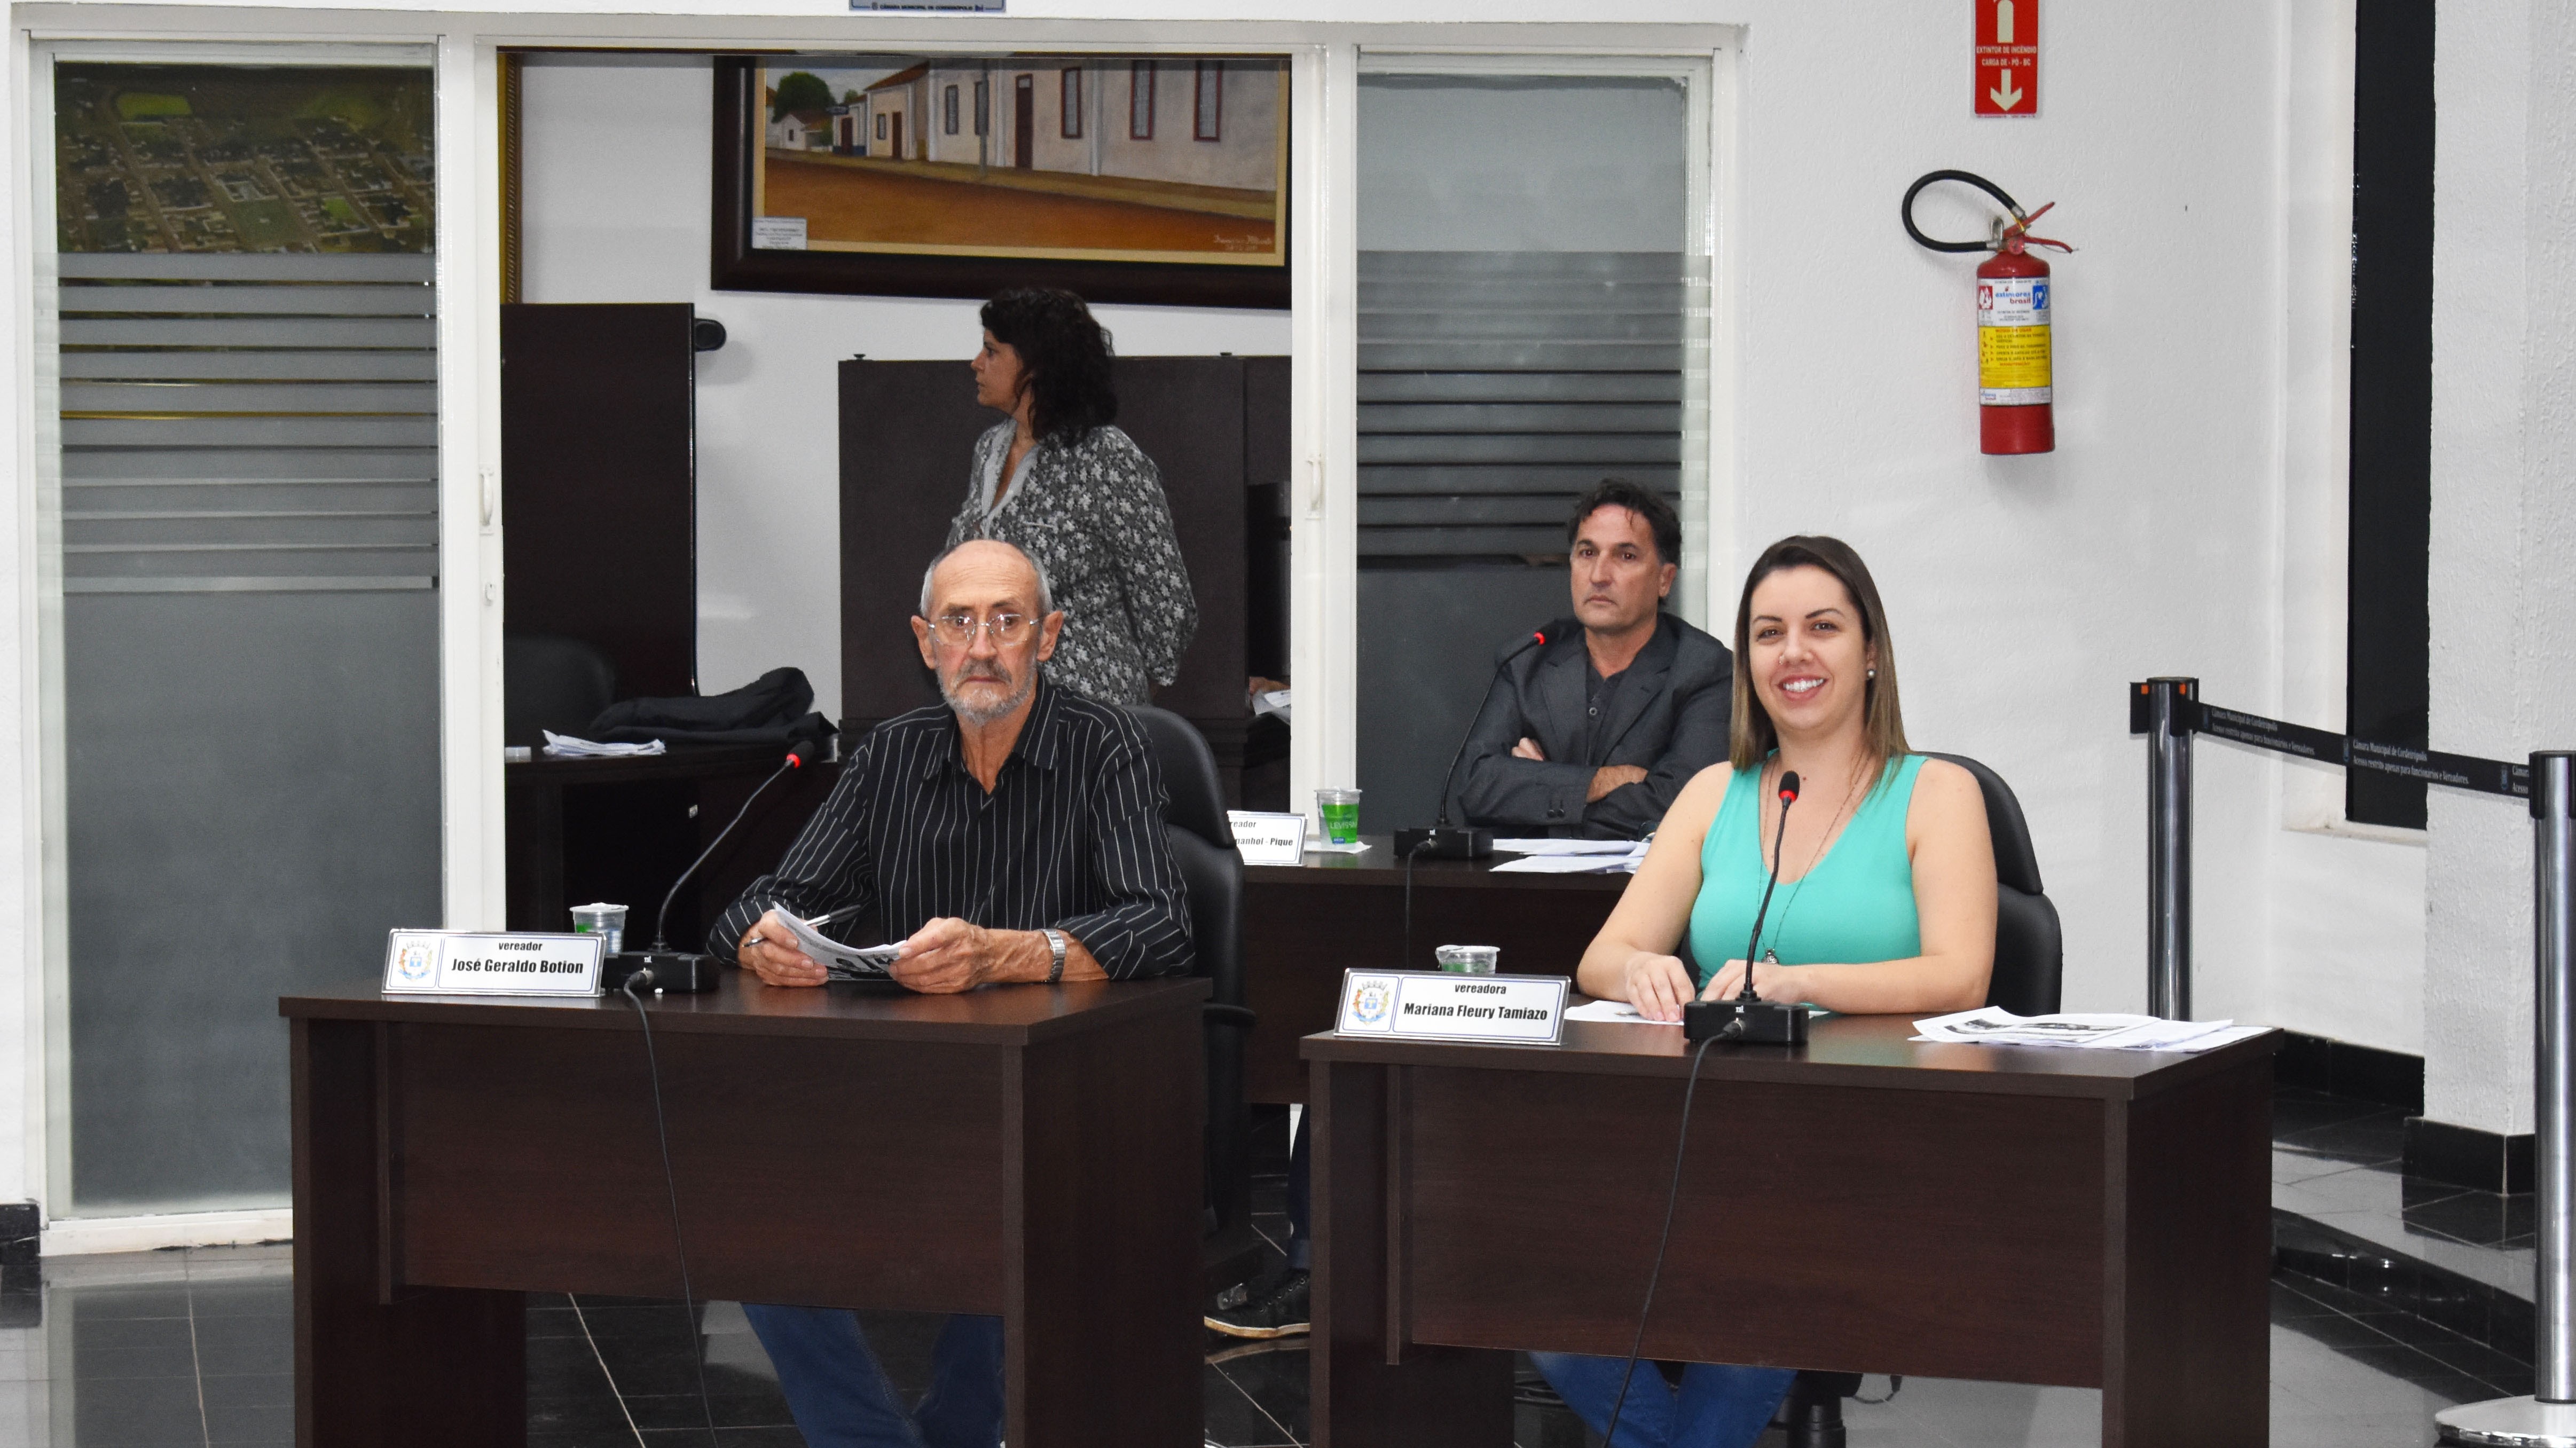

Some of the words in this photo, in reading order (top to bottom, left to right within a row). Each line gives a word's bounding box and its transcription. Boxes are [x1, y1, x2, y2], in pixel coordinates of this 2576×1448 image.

[2353, 738, 2369, 751] Câmara
[2370, 742, 2391, 757] Municipal
[2353, 756, 2367, 766] Acesso
[2400, 766, 2410, 776] para
[2512, 782, 2528, 794] Acesso
[1270, 838, 1293, 846] Pique
[499, 942, 543, 951] vereador
[452, 958, 481, 972] José
[484, 959, 537, 973] Geraldo
[540, 961, 584, 974] Botion
[1455, 984, 1507, 994] vereadora
[1403, 1003, 1454, 1017] Mariana
[1456, 1005, 1496, 1019] Fleury
[1498, 1006, 1548, 1020] Tamiazo
